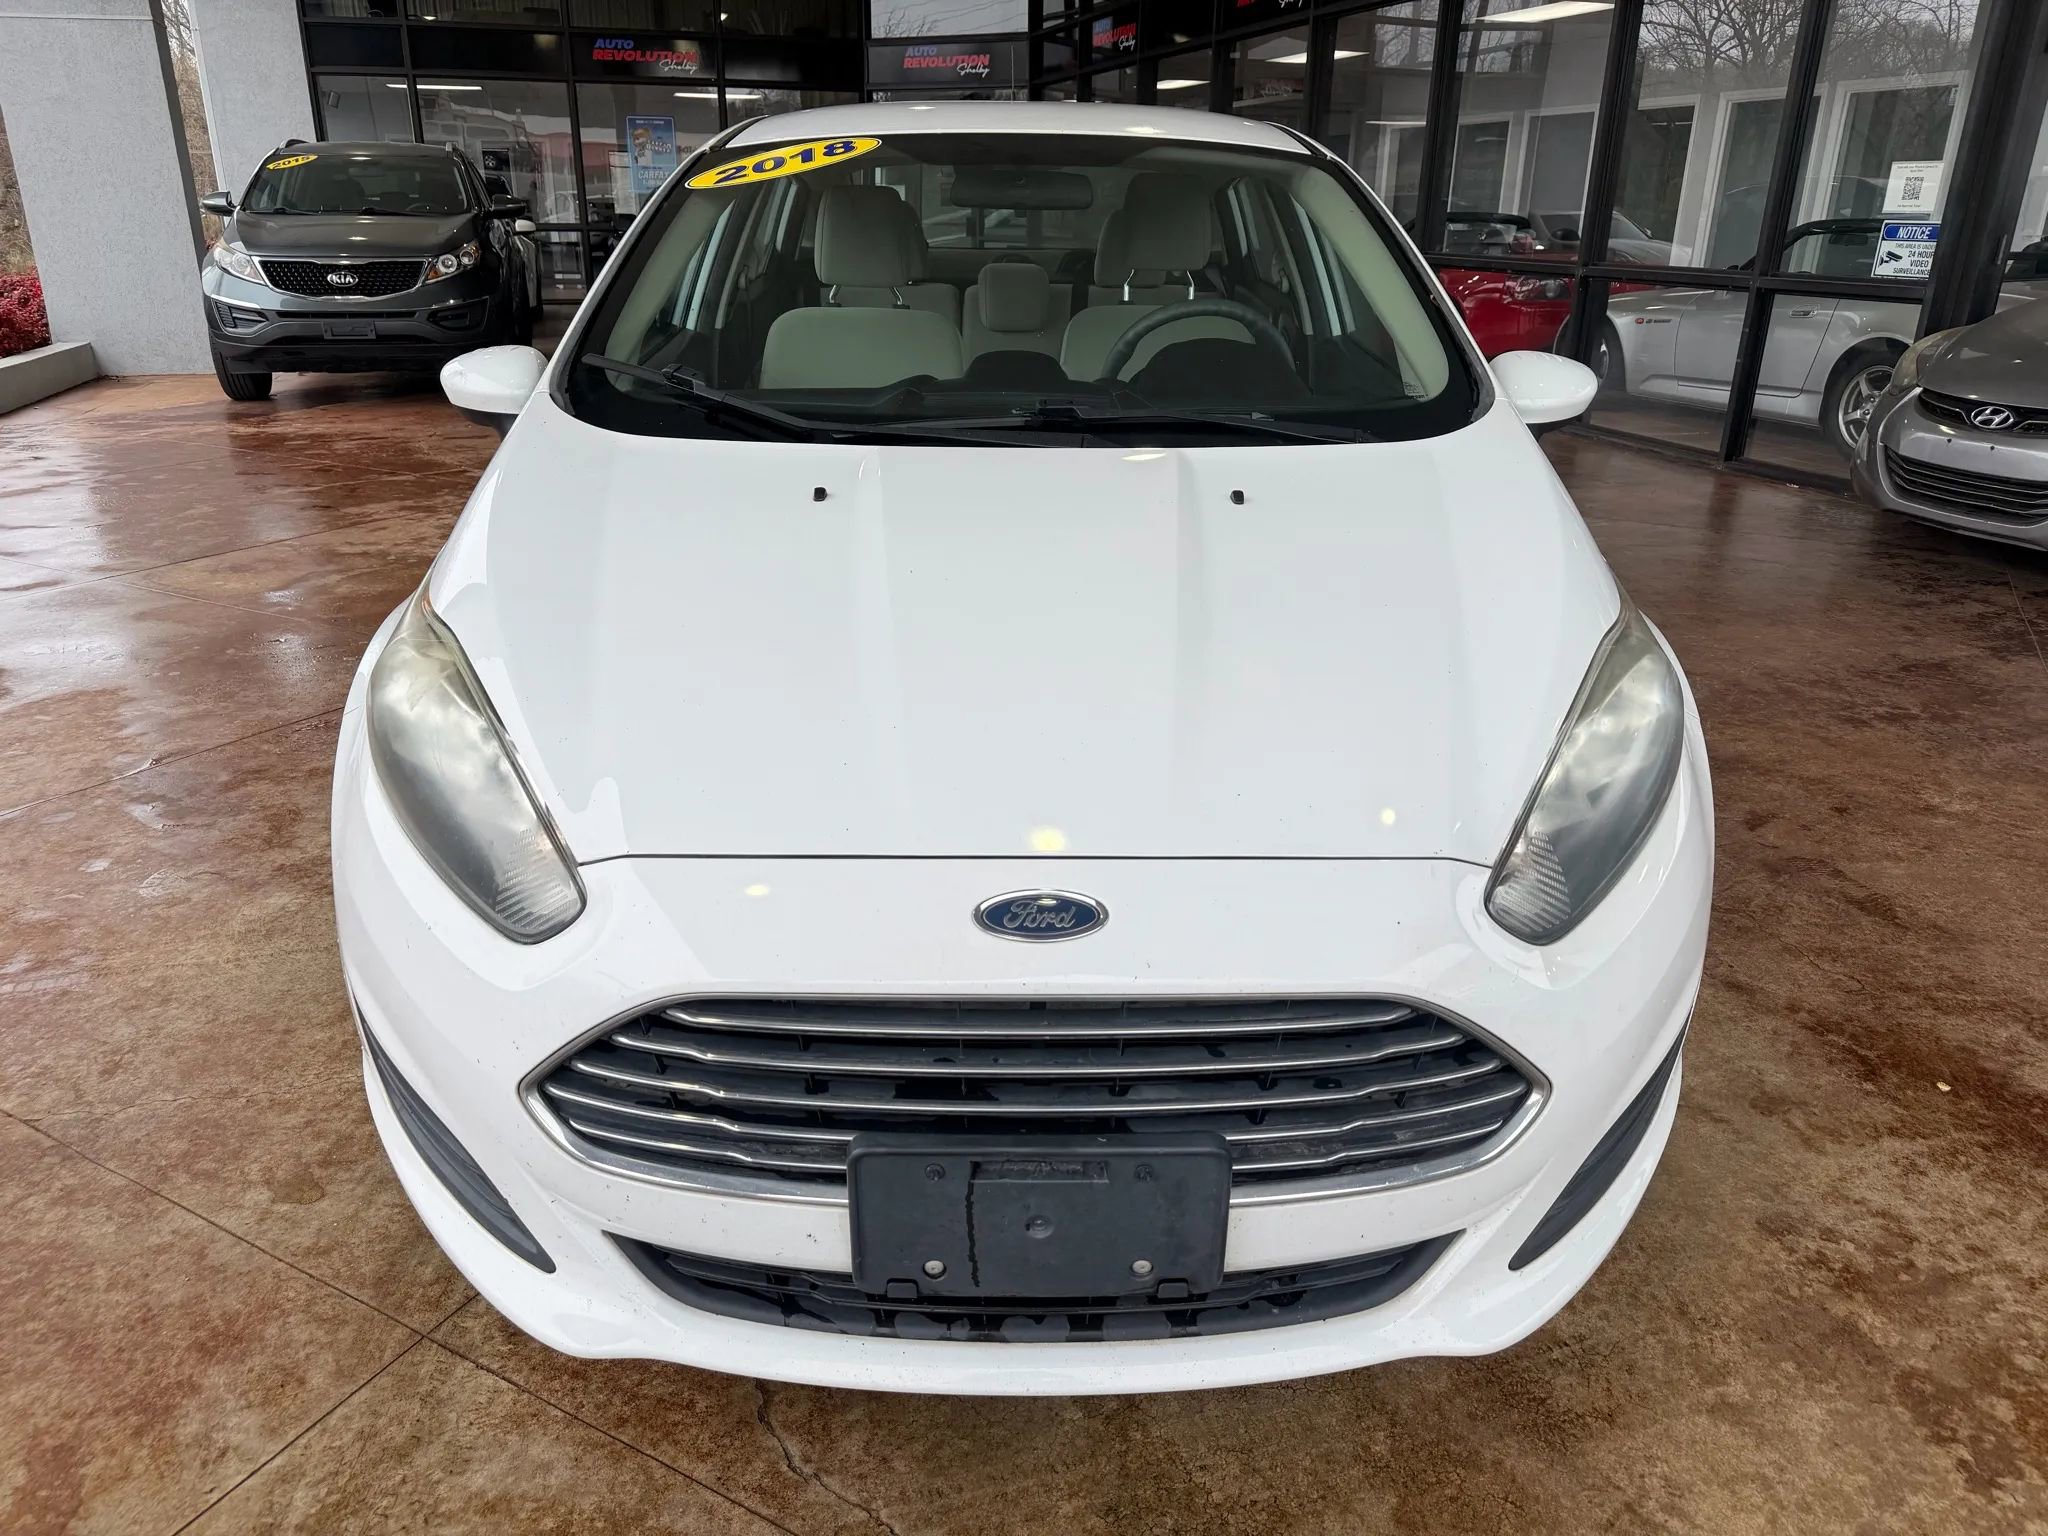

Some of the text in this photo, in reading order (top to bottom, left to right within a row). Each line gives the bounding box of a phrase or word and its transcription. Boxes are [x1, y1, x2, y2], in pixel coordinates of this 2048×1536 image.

[594, 38, 634, 49] AUTO
[592, 49, 698, 64] REVOLUTION
[906, 46, 937, 57] AUTO
[659, 58, 699, 75] Shelby
[904, 54, 990, 68] REVOLUTION
[956, 62, 990, 78] Shelby
[713, 140, 857, 185] 2018
[638, 171, 670, 179] CARFAX
[1896, 226, 1933, 239] NOTICE
[1908, 250, 1916, 258] 24
[1910, 259, 1929, 268] VIDEO
[332, 274, 354, 284] KIA
[1003, 900, 1076, 929] Ford
